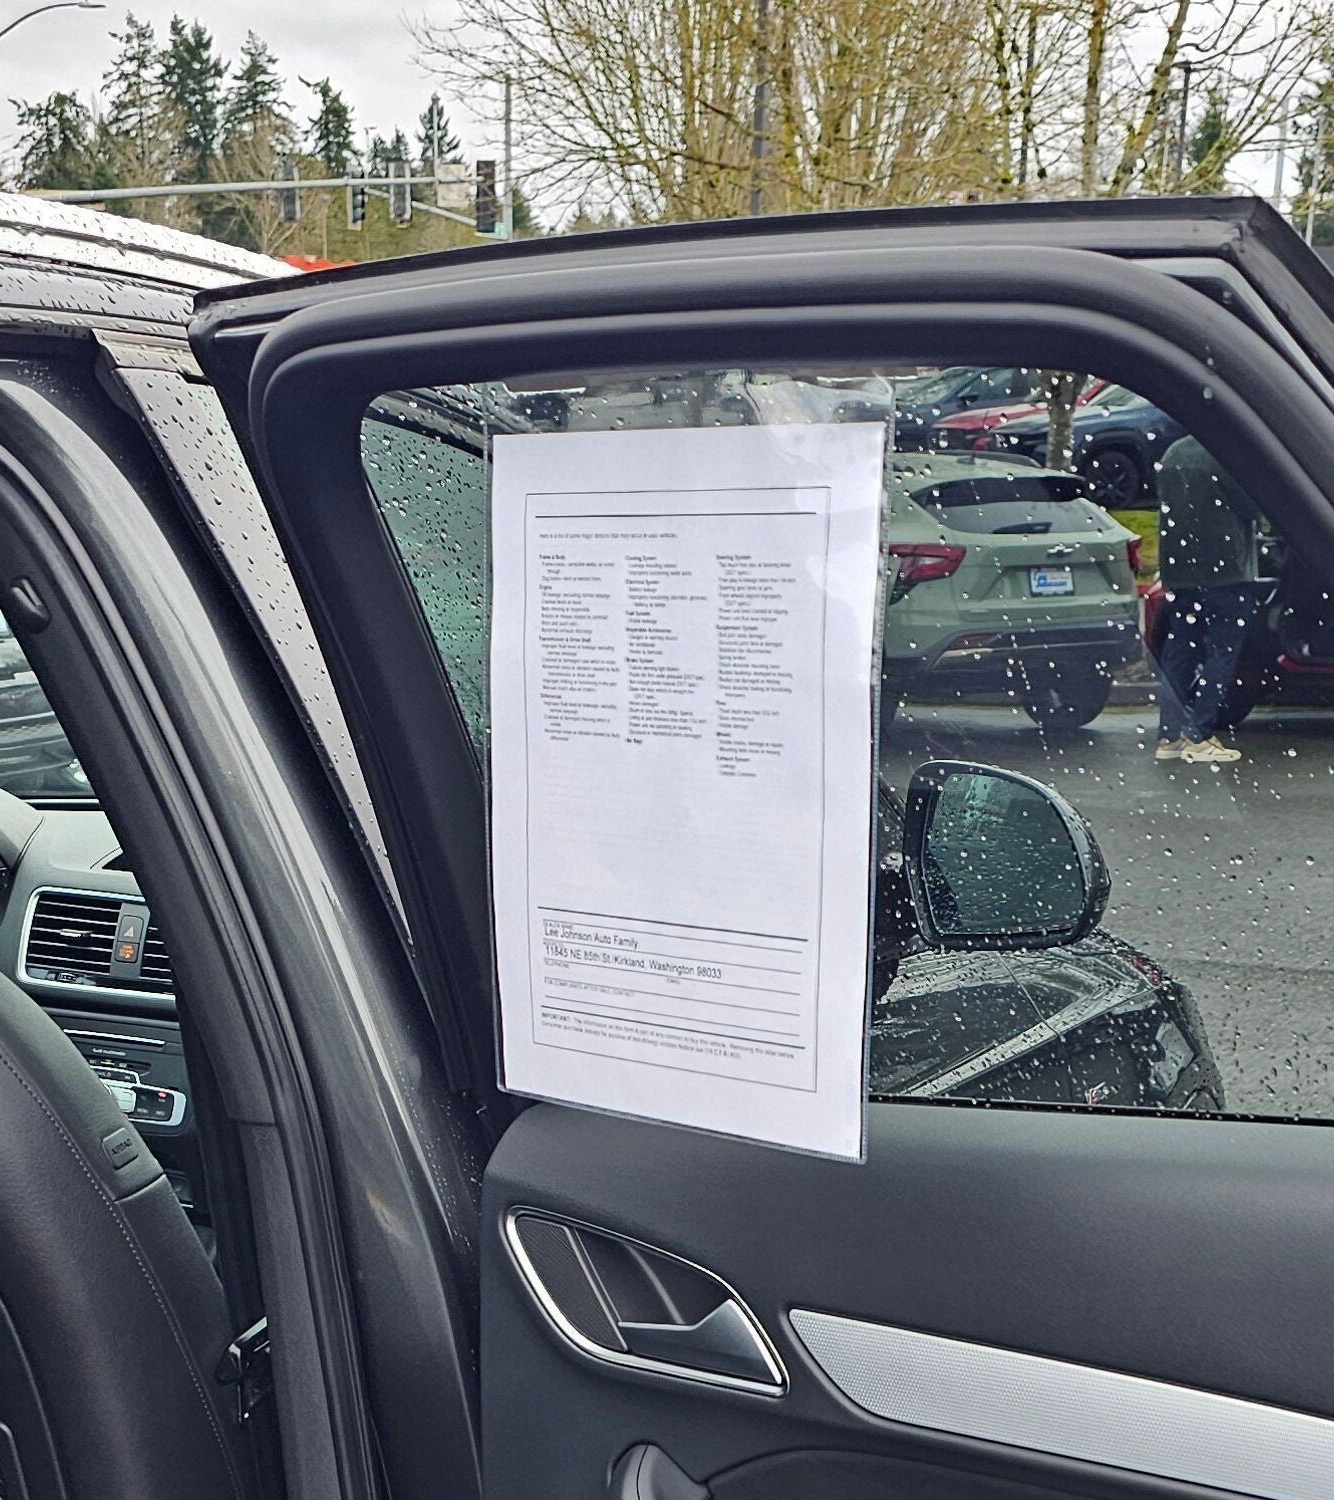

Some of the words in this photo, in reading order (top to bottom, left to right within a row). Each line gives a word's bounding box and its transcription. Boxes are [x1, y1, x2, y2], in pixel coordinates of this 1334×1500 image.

[544, 926, 559, 938] Lee
[560, 928, 592, 941] Johnson
[594, 934, 612, 945] Auto
[613, 936, 639, 950] Family
[570, 949, 582, 960] NE
[648, 959, 695, 976] Washington
[696, 965, 723, 979] 98033
